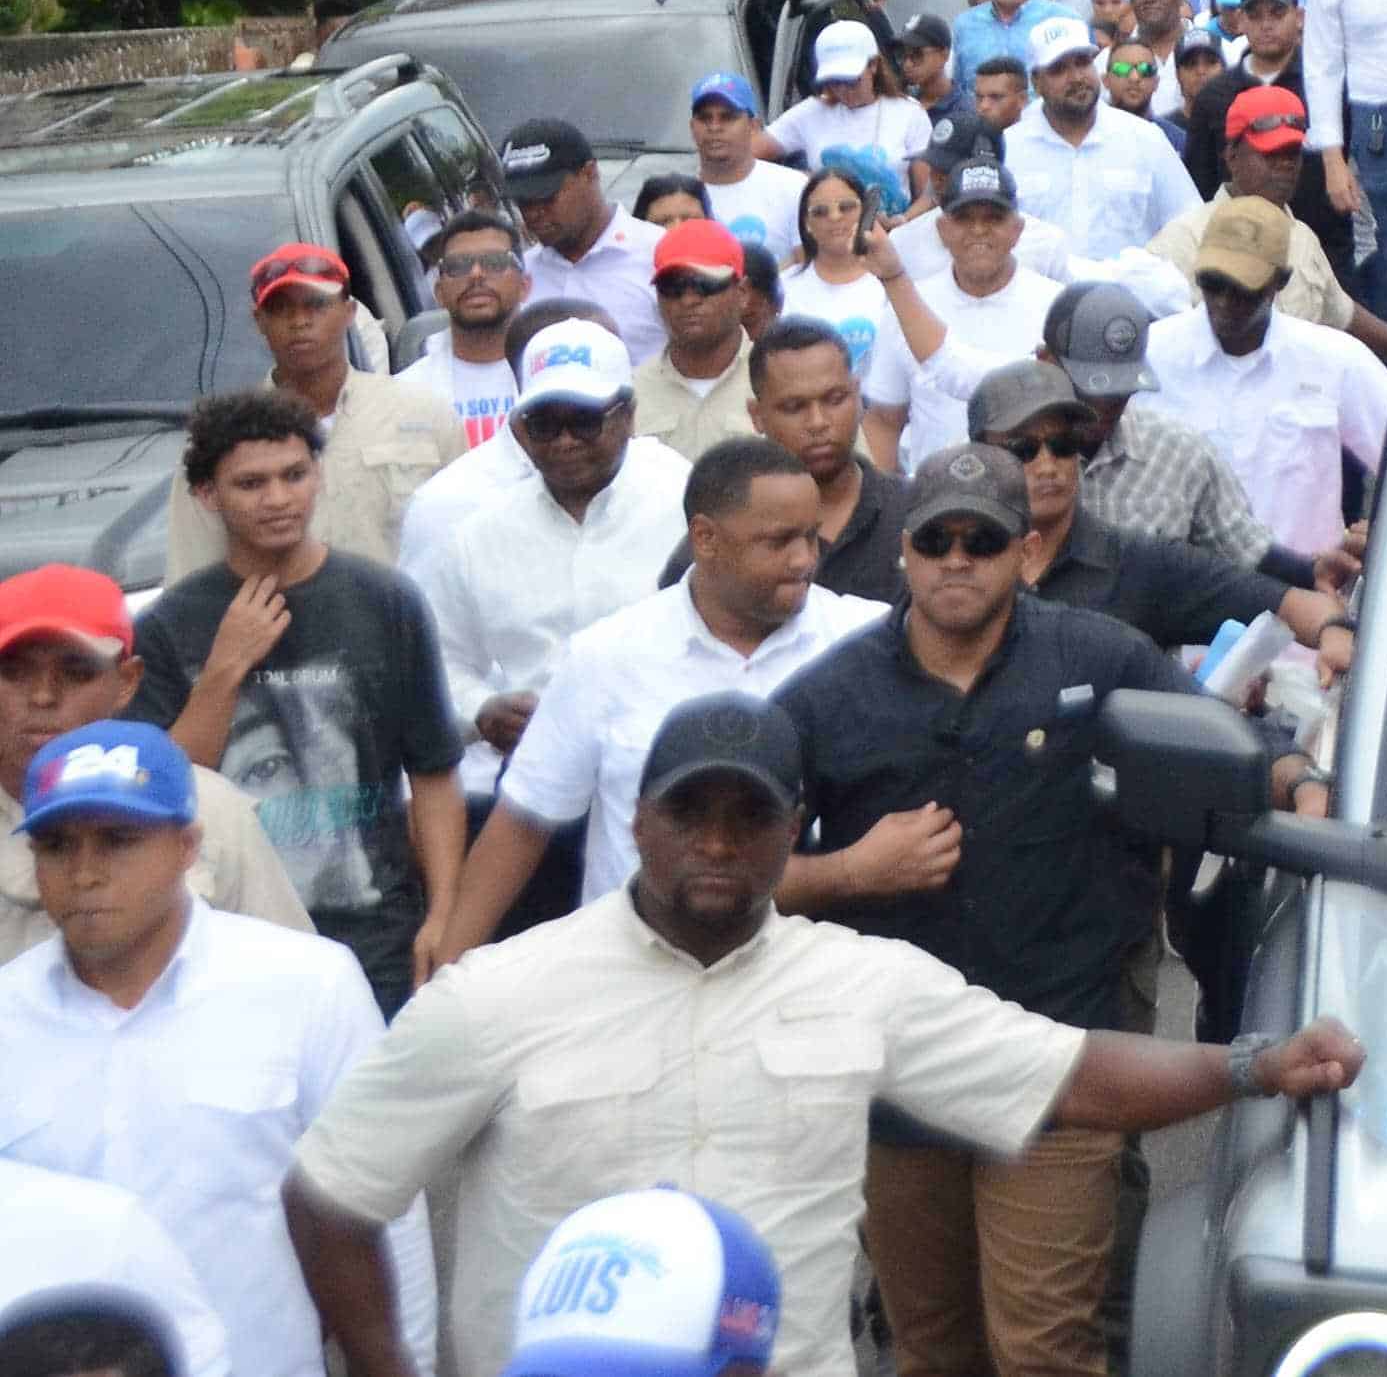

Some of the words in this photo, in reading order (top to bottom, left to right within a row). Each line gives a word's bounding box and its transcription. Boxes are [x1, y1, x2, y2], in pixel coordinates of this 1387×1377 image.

[547, 344, 592, 367] 24
[469, 398, 499, 415] SOY
[62, 743, 139, 783] 24
[529, 1250, 631, 1321] LUIS
